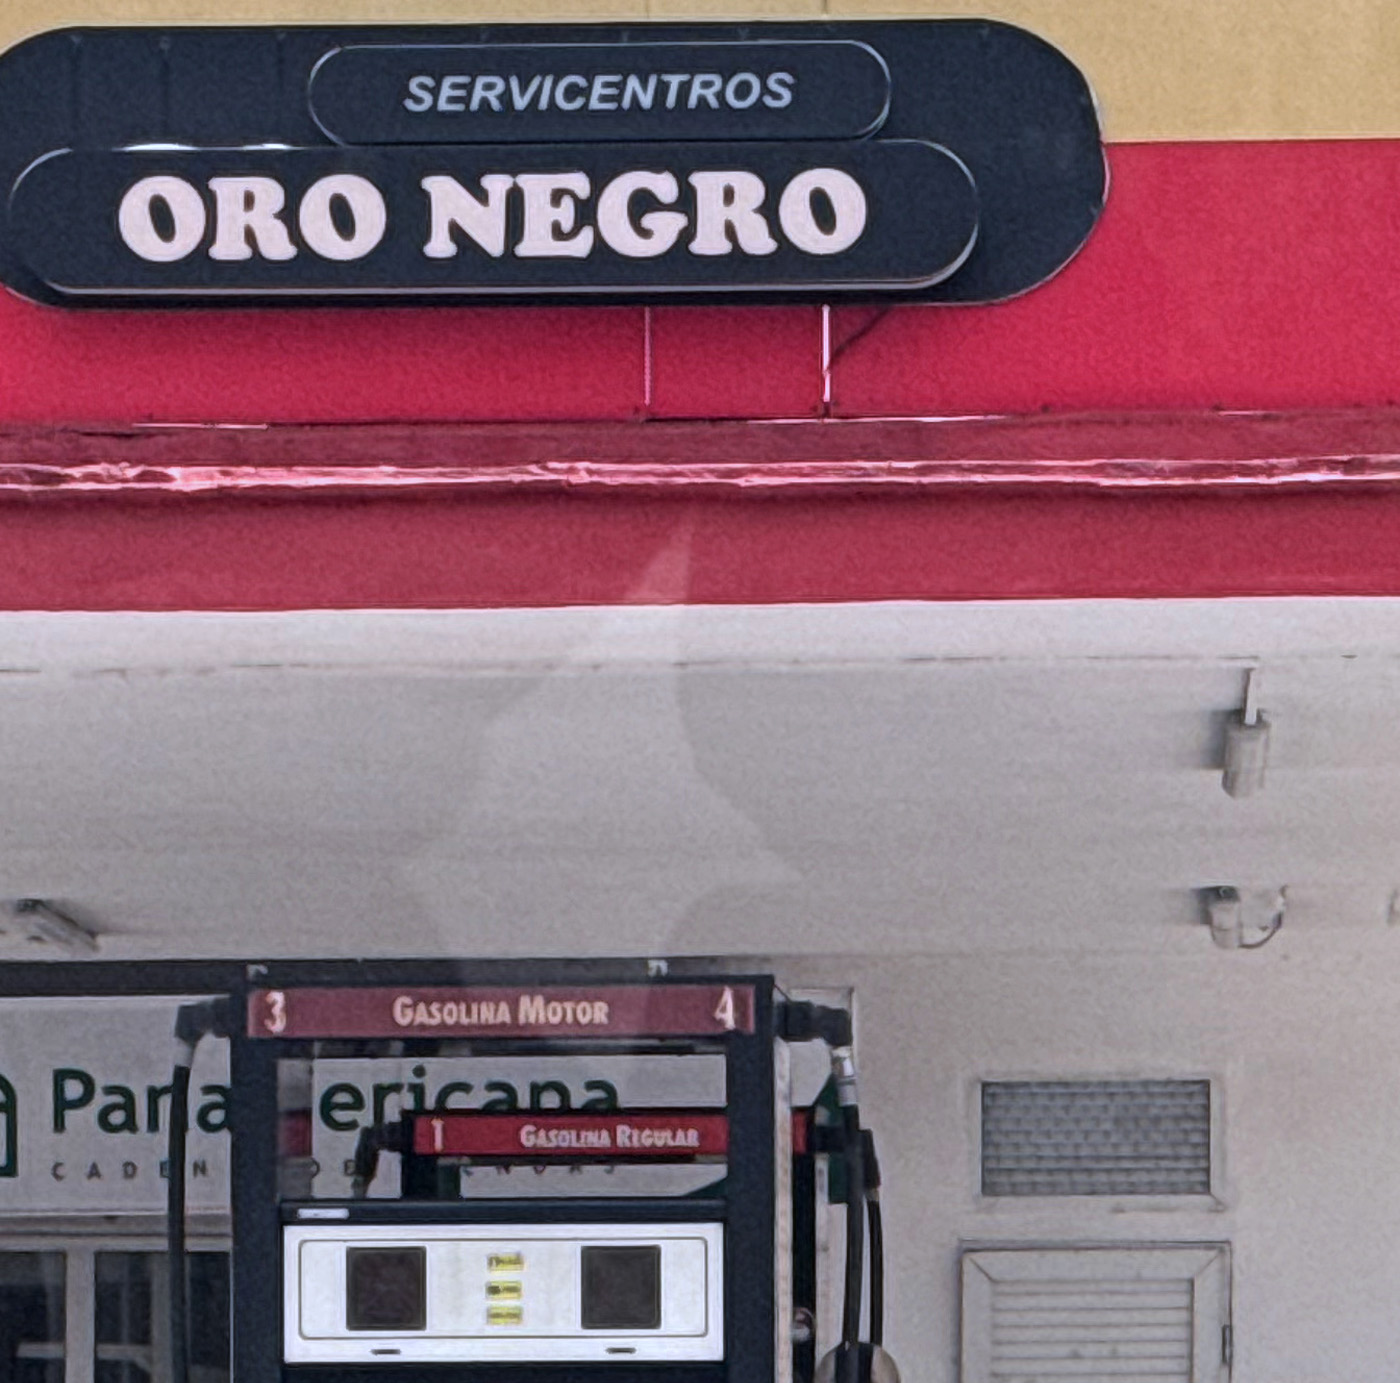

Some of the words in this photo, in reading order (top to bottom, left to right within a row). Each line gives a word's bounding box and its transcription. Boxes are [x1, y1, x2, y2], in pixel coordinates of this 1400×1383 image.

[404, 70, 796, 112] SERVICENTROS
[117, 172, 387, 263] ORO
[421, 167, 868, 260] NEGRO
[264, 989, 286, 1034] 3
[392, 996, 511, 1027] GASOLINA
[518, 995, 610, 1026] MOTOR
[713, 985, 736, 1031] 4
[431, 1118, 445, 1151] 1
[519, 1124, 611, 1149] GASOLINA
[615, 1125, 700, 1149] REGULAR
